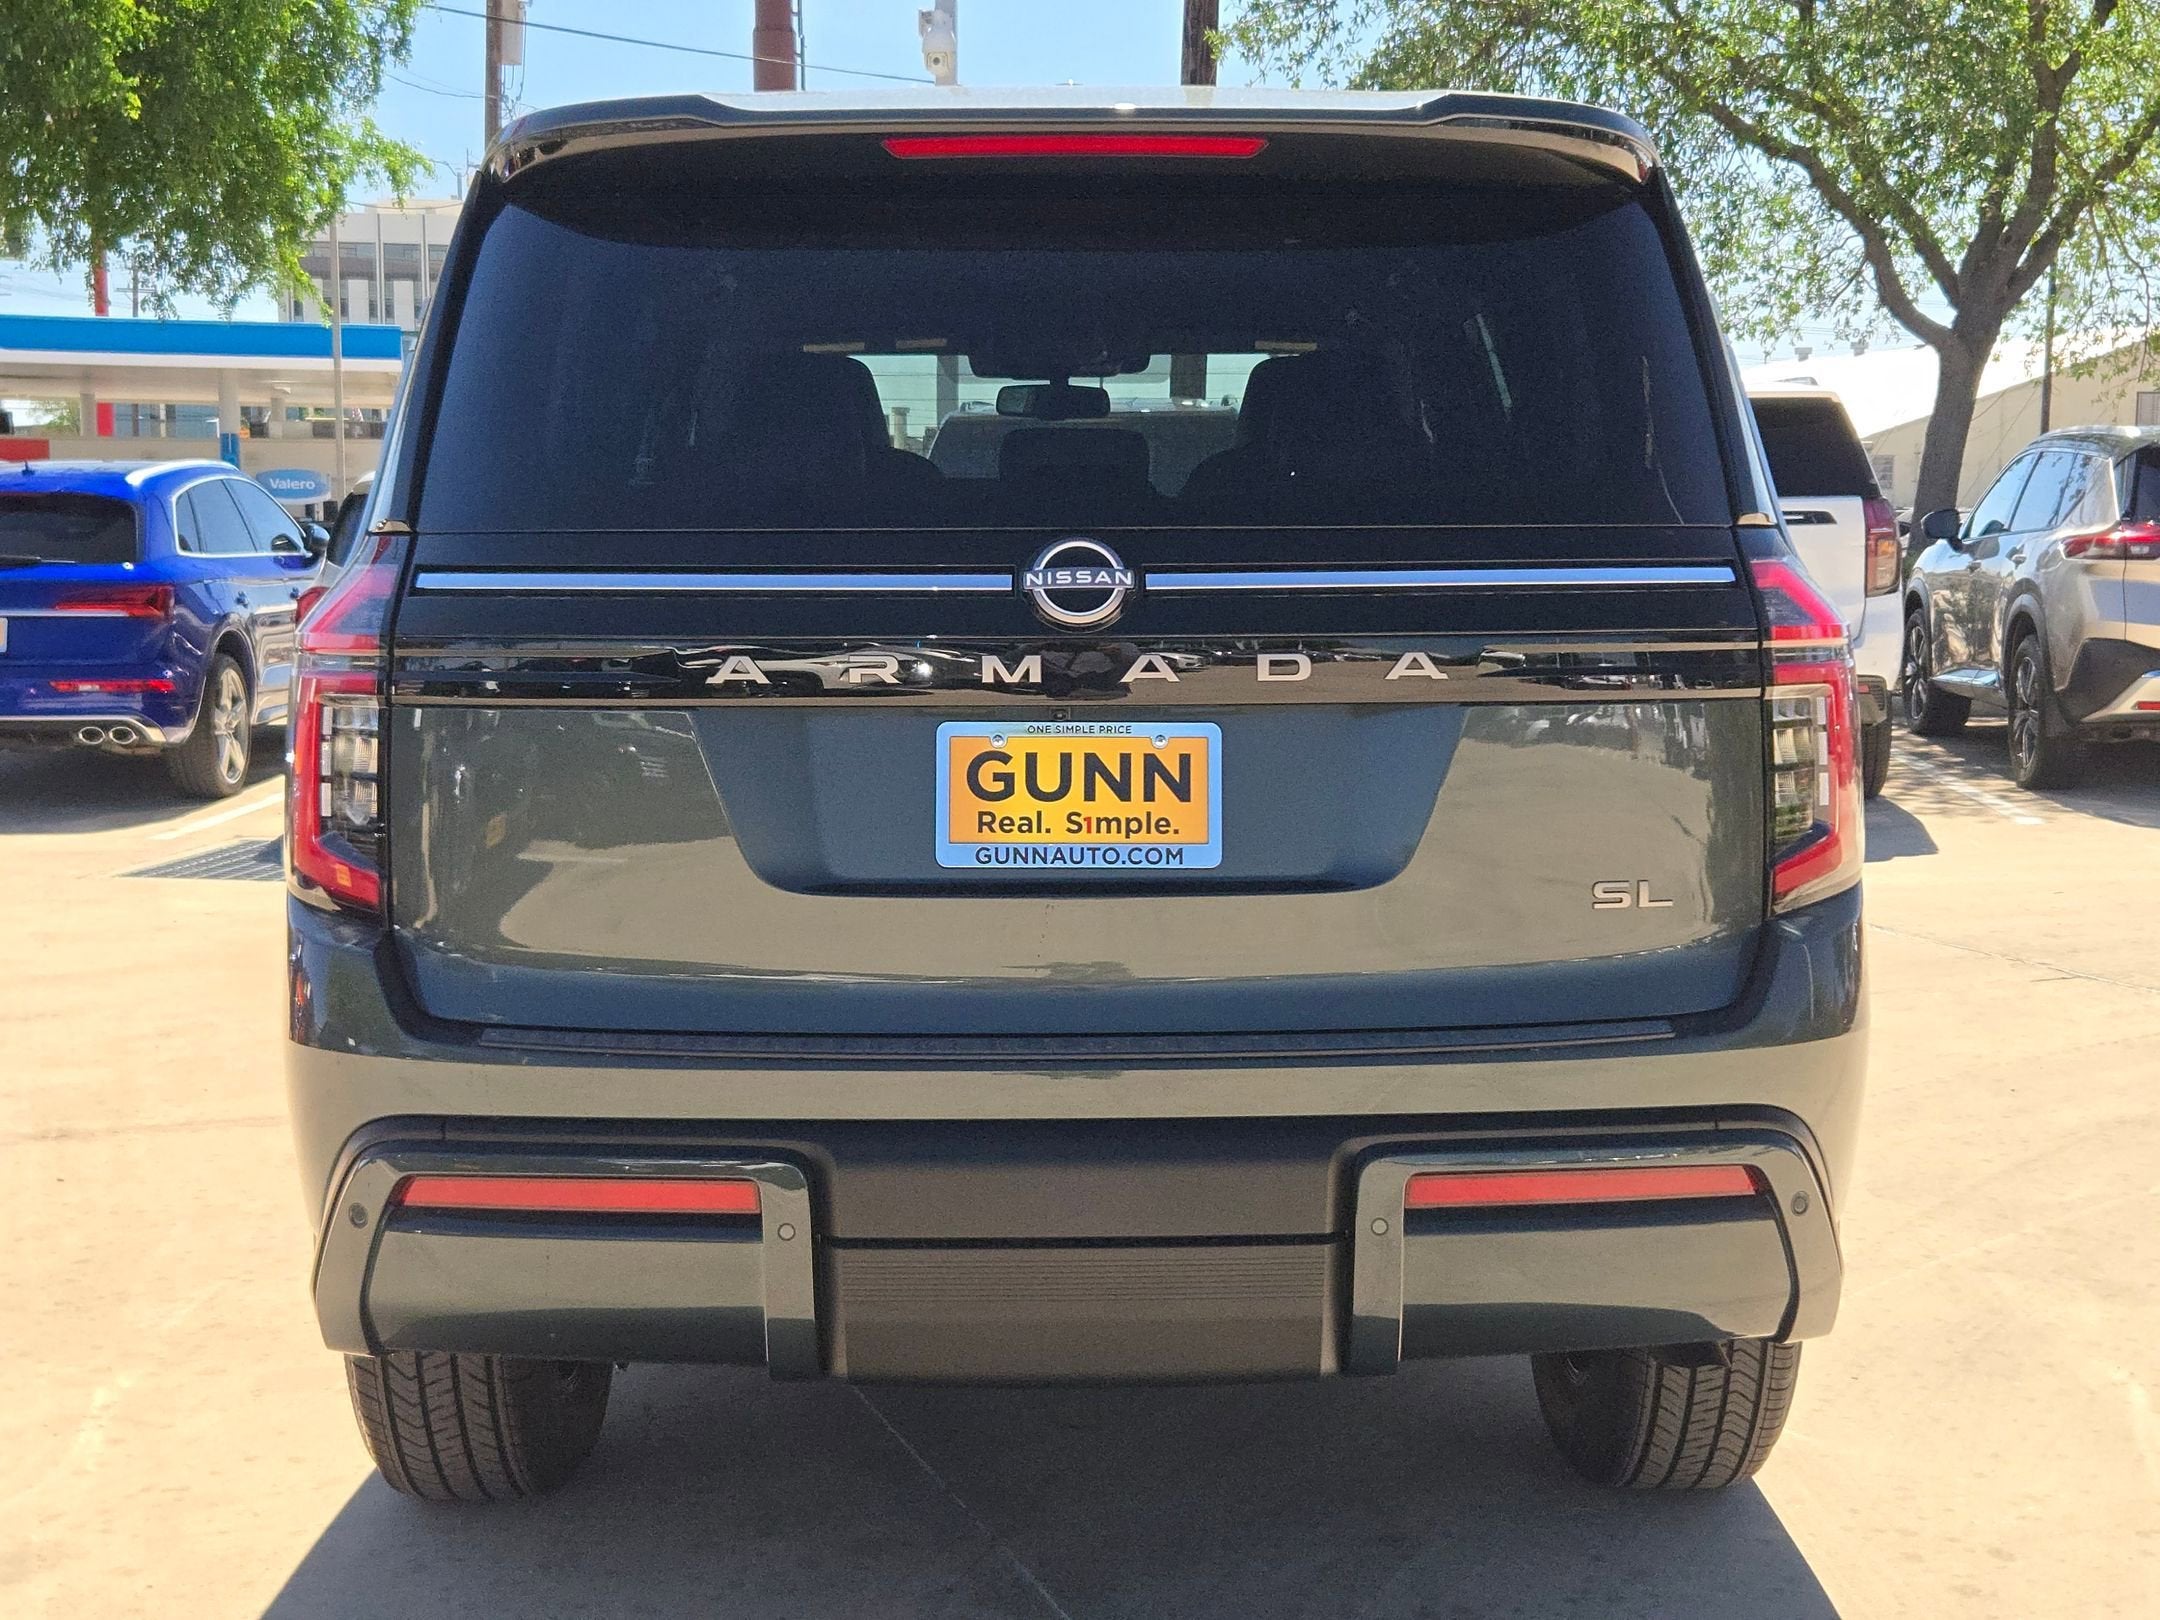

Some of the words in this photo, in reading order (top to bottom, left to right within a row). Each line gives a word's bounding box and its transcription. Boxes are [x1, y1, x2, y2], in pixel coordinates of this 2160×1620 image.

[269, 478, 316, 490] Valero
[1026, 571, 1132, 586] NISSAN
[705, 652, 1449, 684] ARMADA
[1027, 725, 1051, 735] ONE
[1055, 725, 1095, 735] SIMPLE
[1099, 725, 1132, 735] PRICE
[966, 750, 1192, 803] GUNN
[977, 811, 1051, 834] Real.
[975, 847, 1184, 865] GUNNAUTO.COM
[1592, 880, 1674, 909] SL
